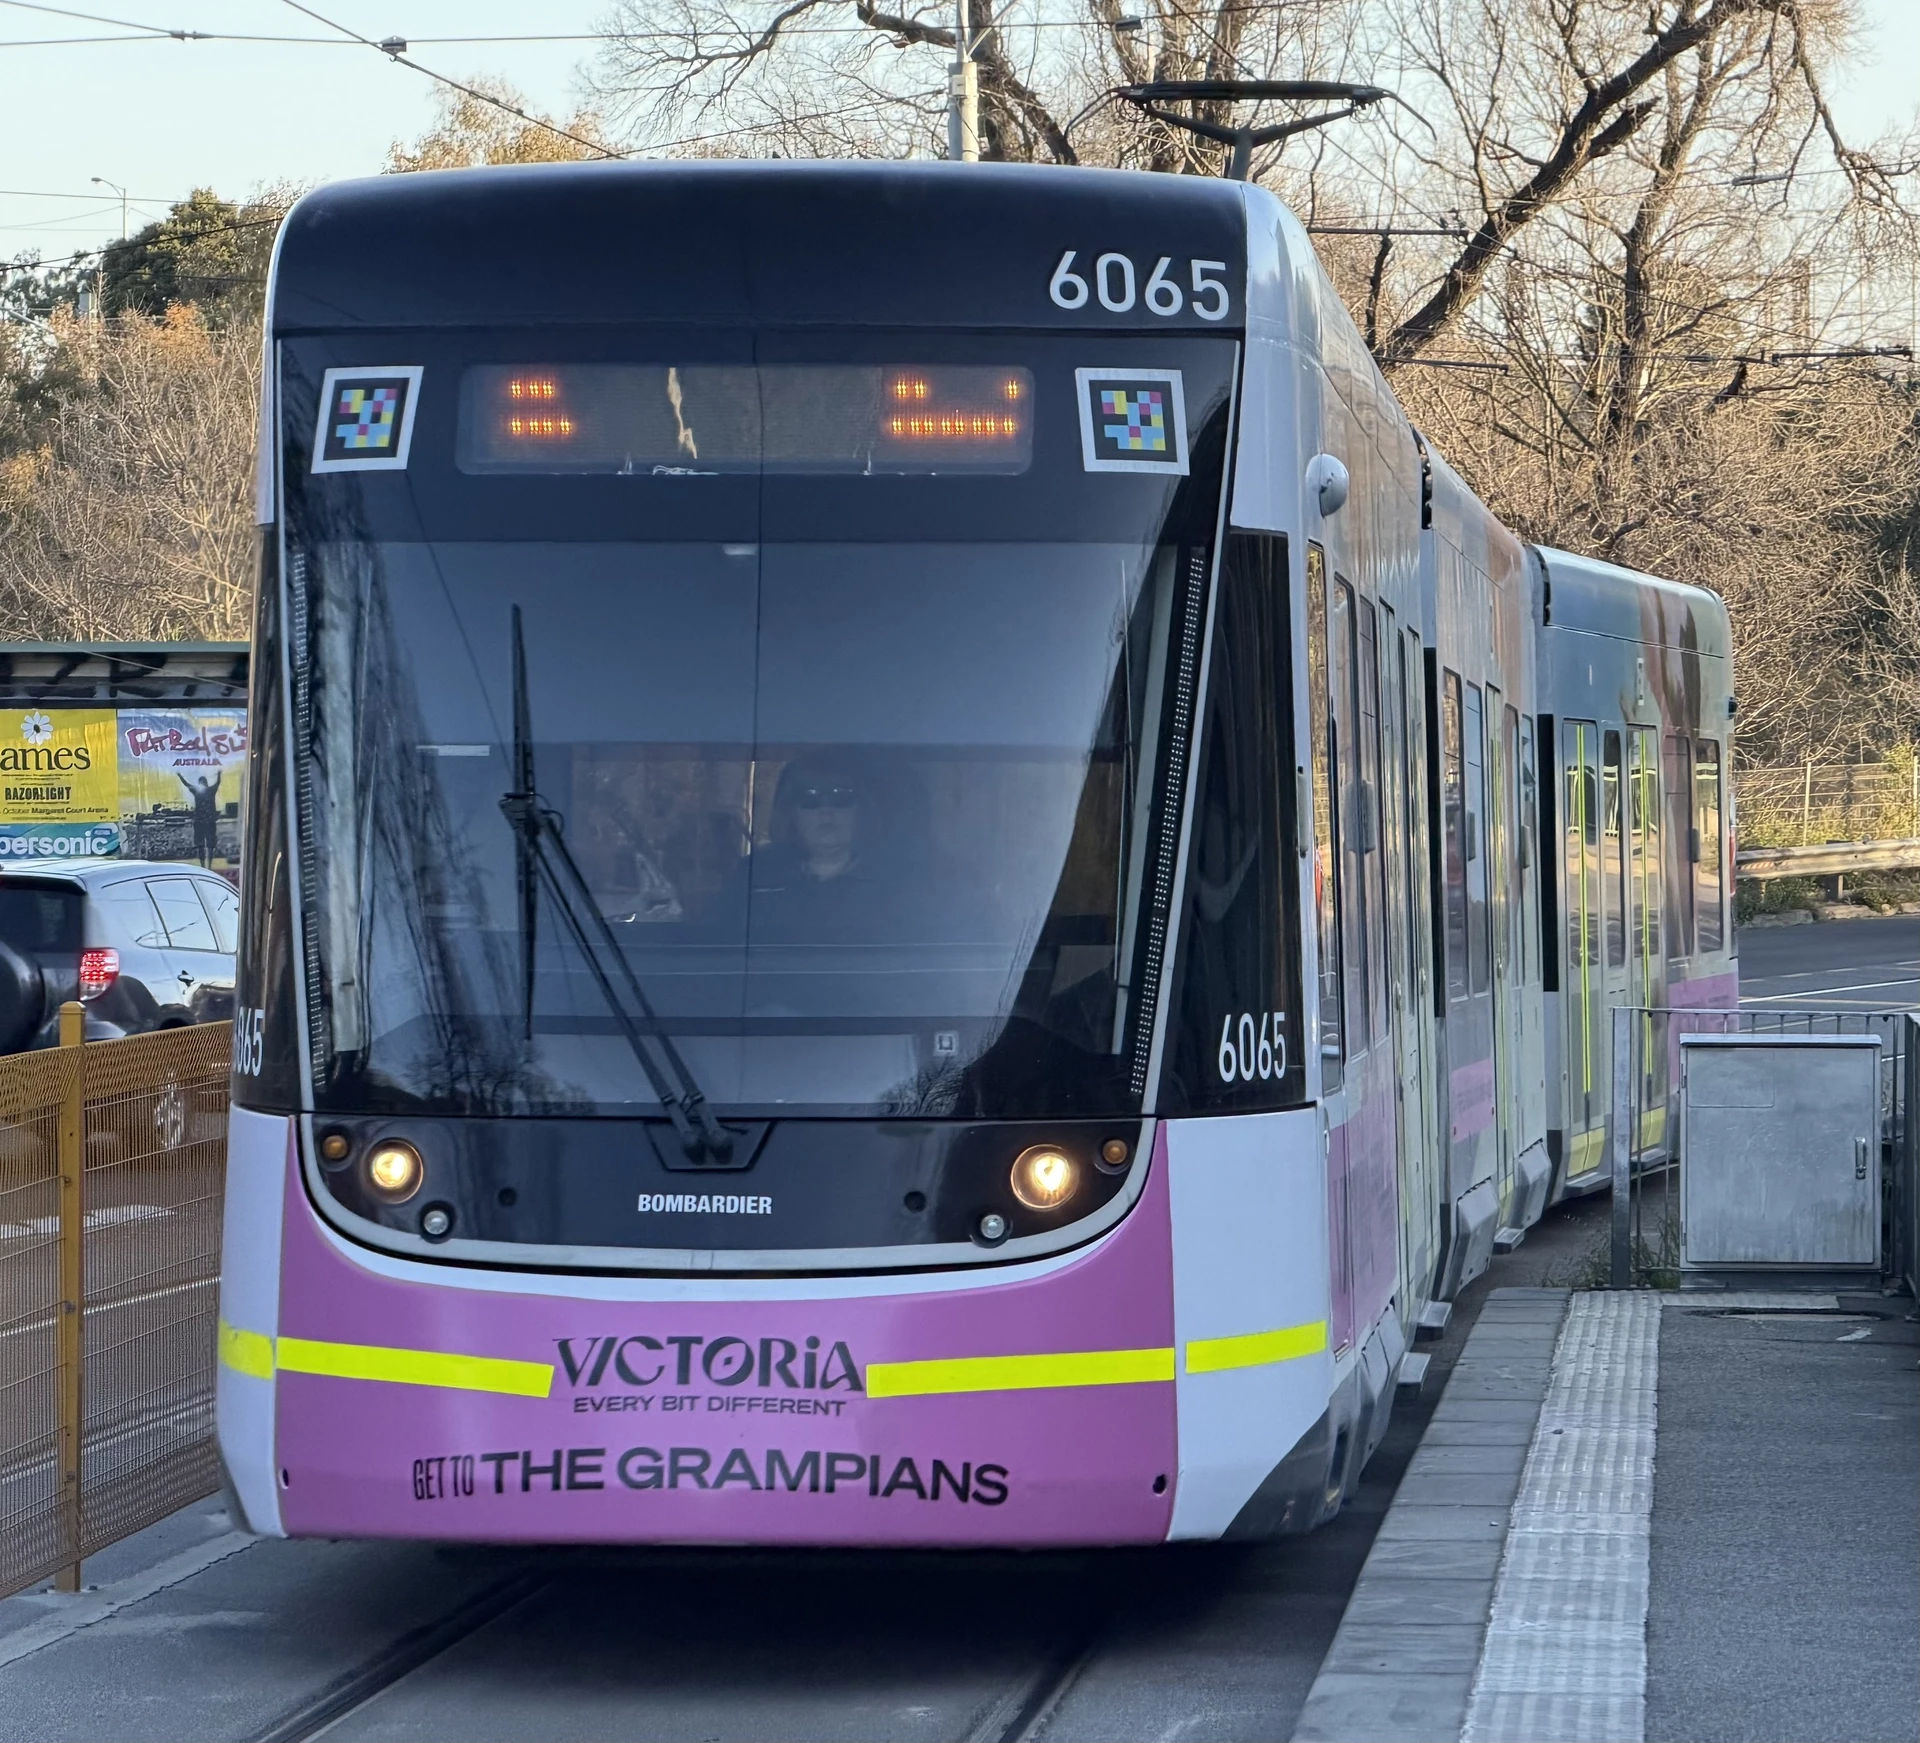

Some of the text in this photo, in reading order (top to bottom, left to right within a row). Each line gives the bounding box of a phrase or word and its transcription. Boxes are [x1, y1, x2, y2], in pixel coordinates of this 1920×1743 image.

[1050, 250, 1230, 321] 6065
[172, 758, 223, 767] AUSTRALIA
[5, 787, 72, 800] RAZORLIGHT
[31, 807, 65, 815] Margaret
[1219, 1011, 1287, 1083] 6065
[638, 1194, 773, 1214] BOMBARDIER
[573, 1395, 847, 1416] EVERY BIT DIFFERENT
[413, 1446, 1009, 1506] GET TO THE GRAMPIANS
